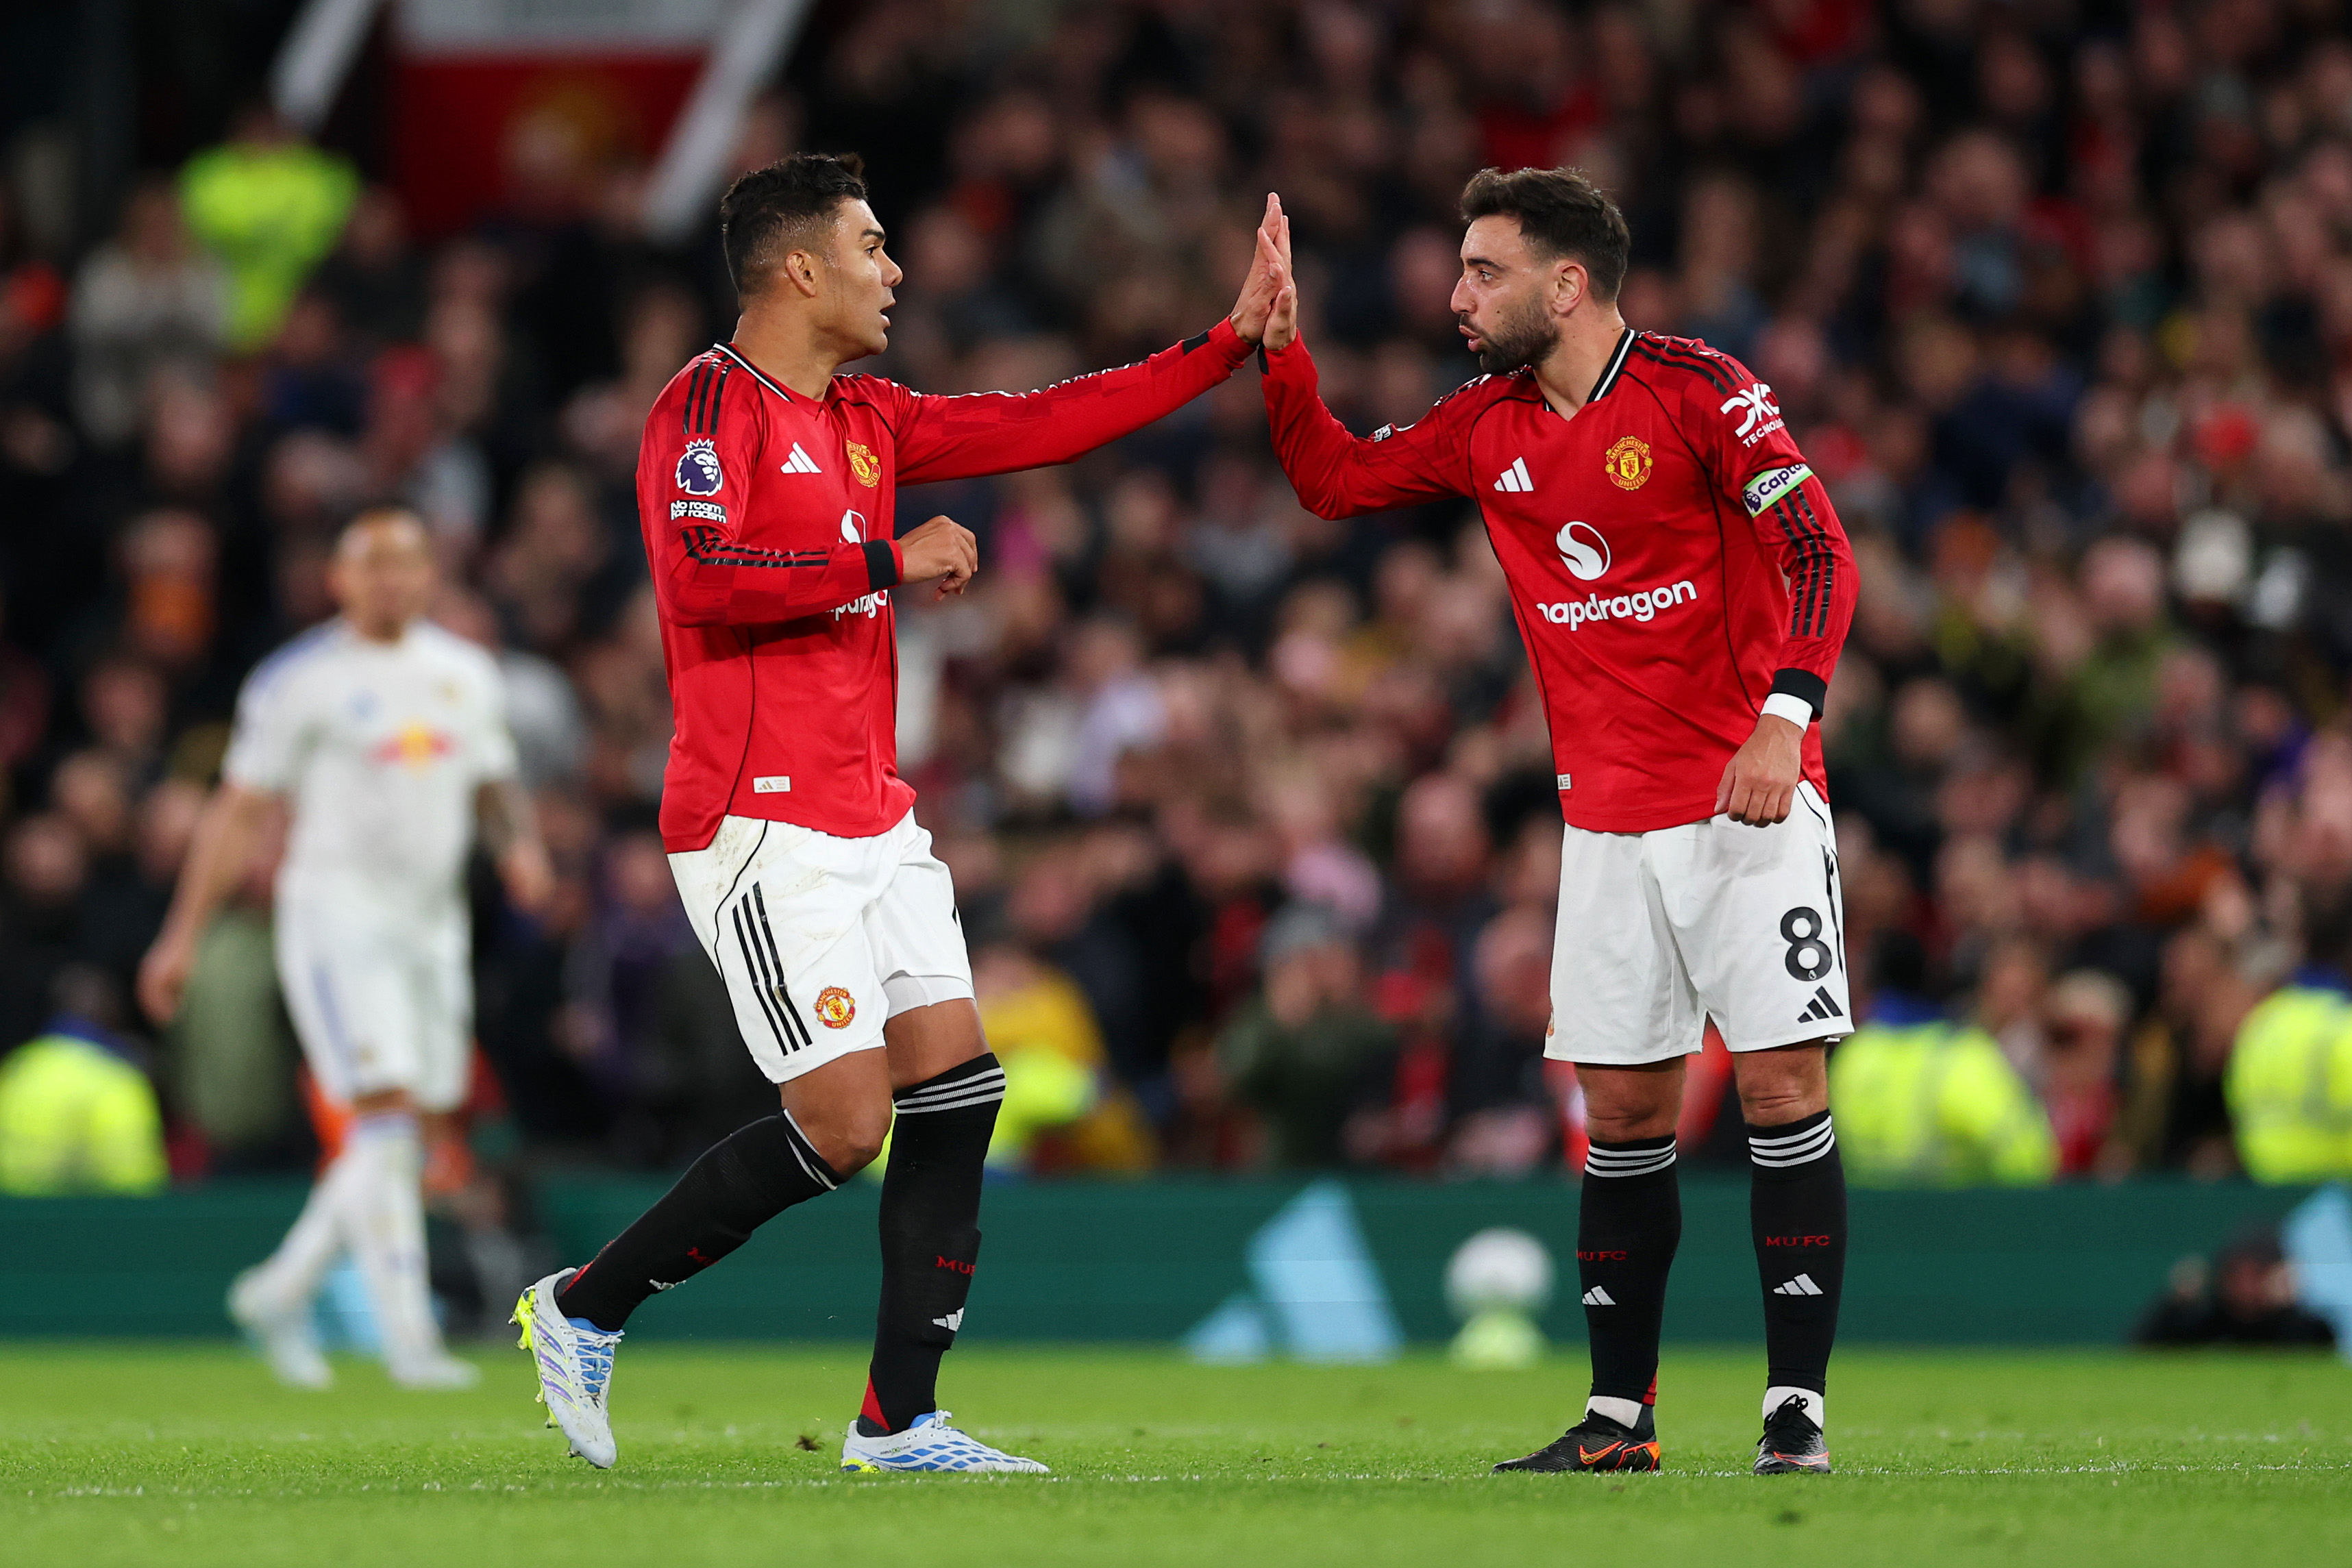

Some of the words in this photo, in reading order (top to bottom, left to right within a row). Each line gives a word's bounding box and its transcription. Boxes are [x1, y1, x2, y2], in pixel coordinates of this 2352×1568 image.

[1610, 440, 1648, 460] MANCHESTER
[1618, 475, 1646, 487] UNITED
[671, 500, 688, 510] No
[689, 501, 721, 514] room
[688, 510, 727, 524] racism
[1536, 580, 1698, 632] napdragon
[1780, 906, 1832, 982] 8
[832, 1013, 853, 1027] UNITED
[1766, 1235, 1830, 1247] MUFC
[935, 1256, 976, 1276] MUF
